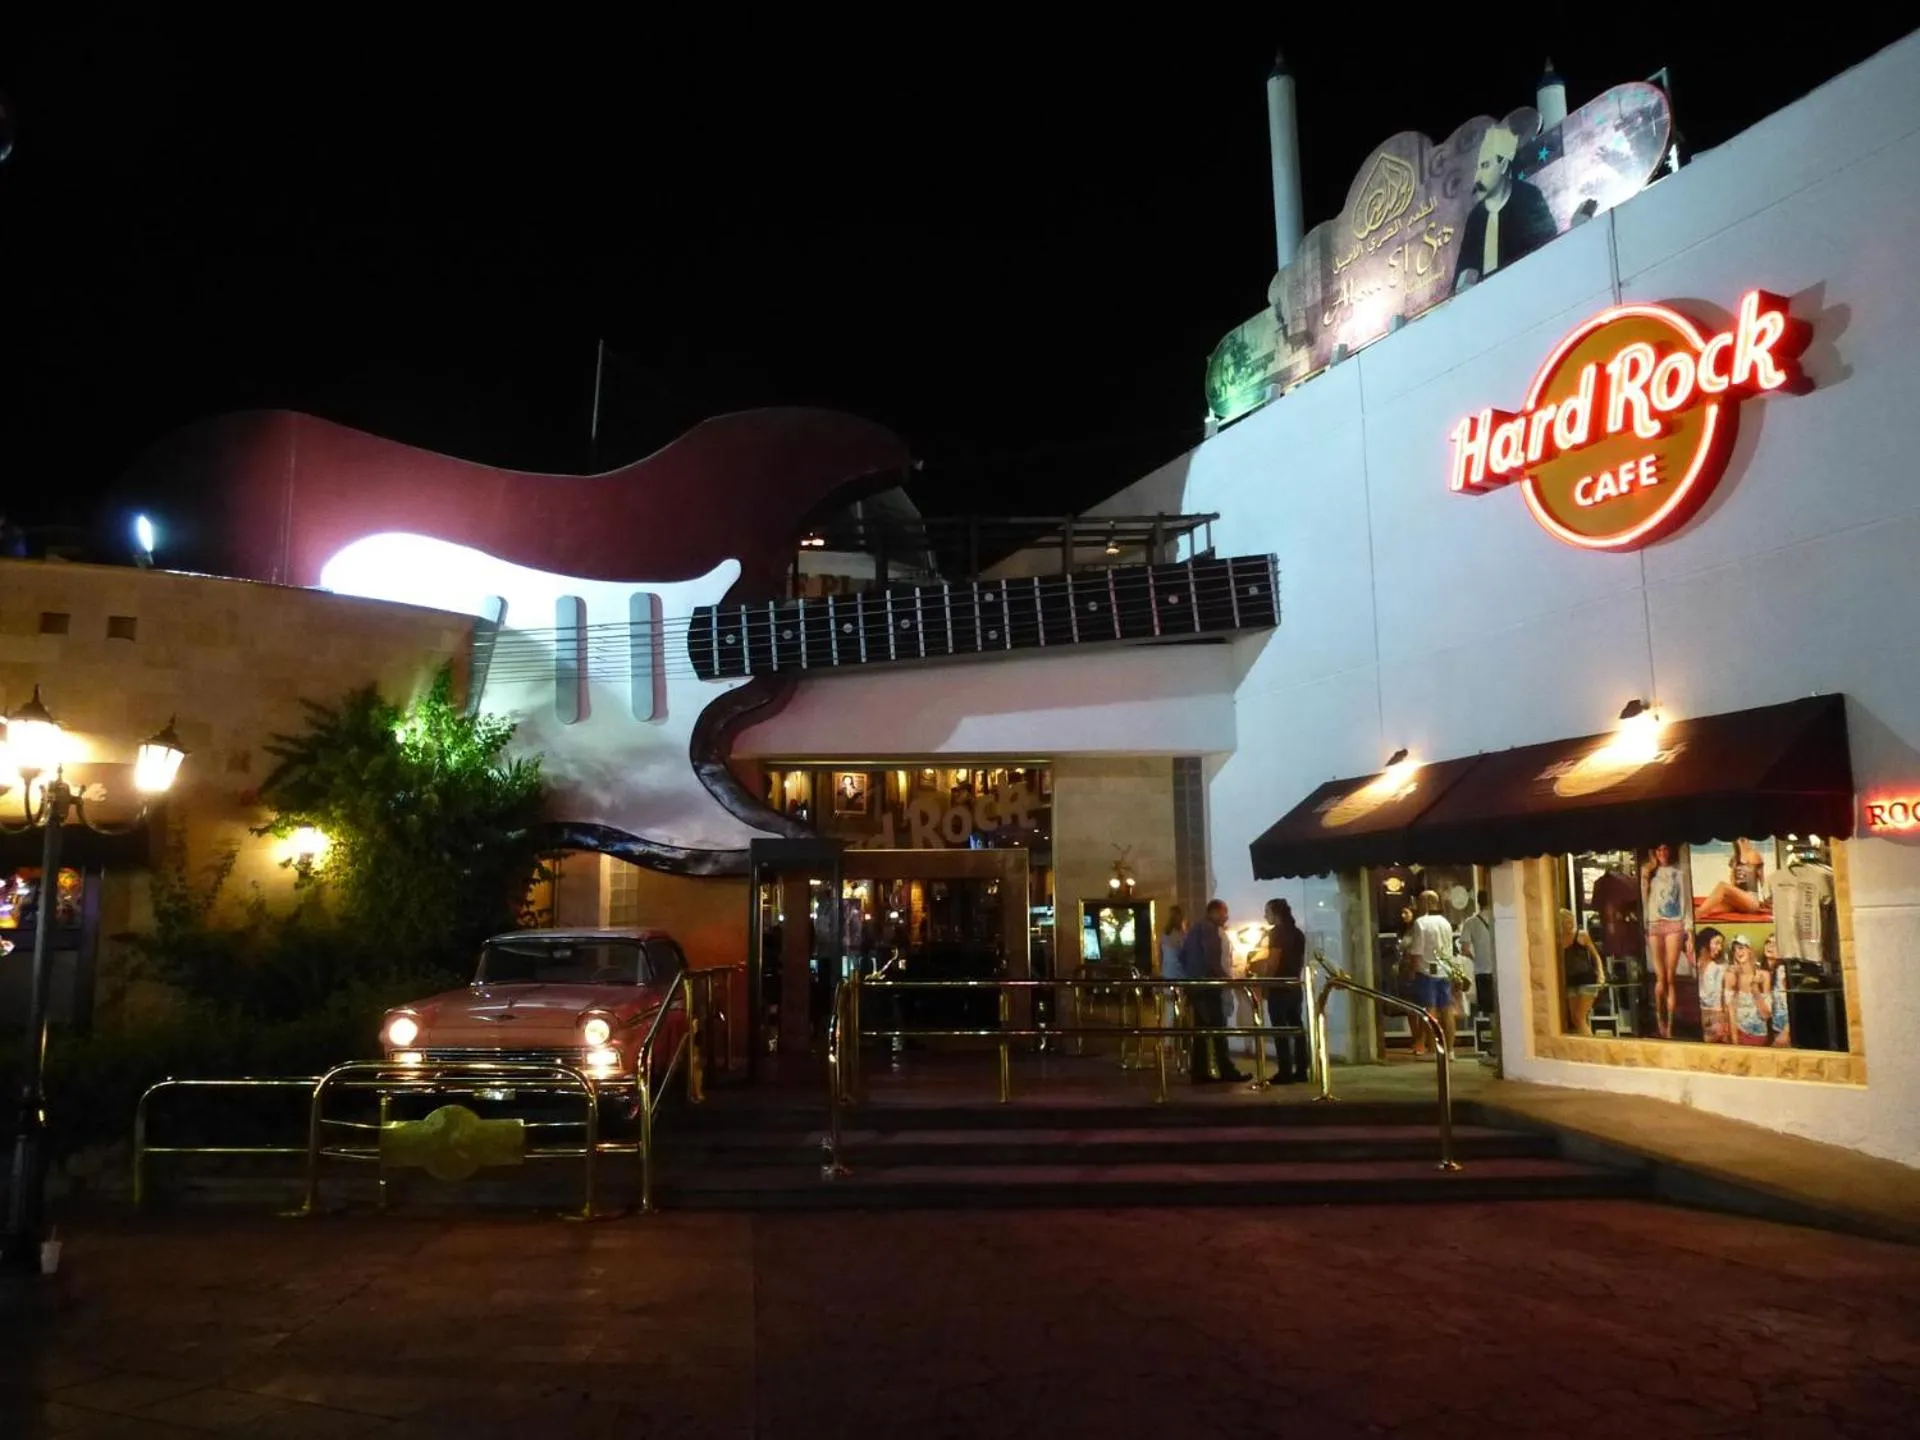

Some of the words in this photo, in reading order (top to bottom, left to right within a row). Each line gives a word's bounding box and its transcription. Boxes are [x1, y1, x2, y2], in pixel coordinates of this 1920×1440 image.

[1448, 362, 1597, 493] Hard
[1606, 288, 1788, 440] Rock
[1573, 453, 1659, 507] CAFE
